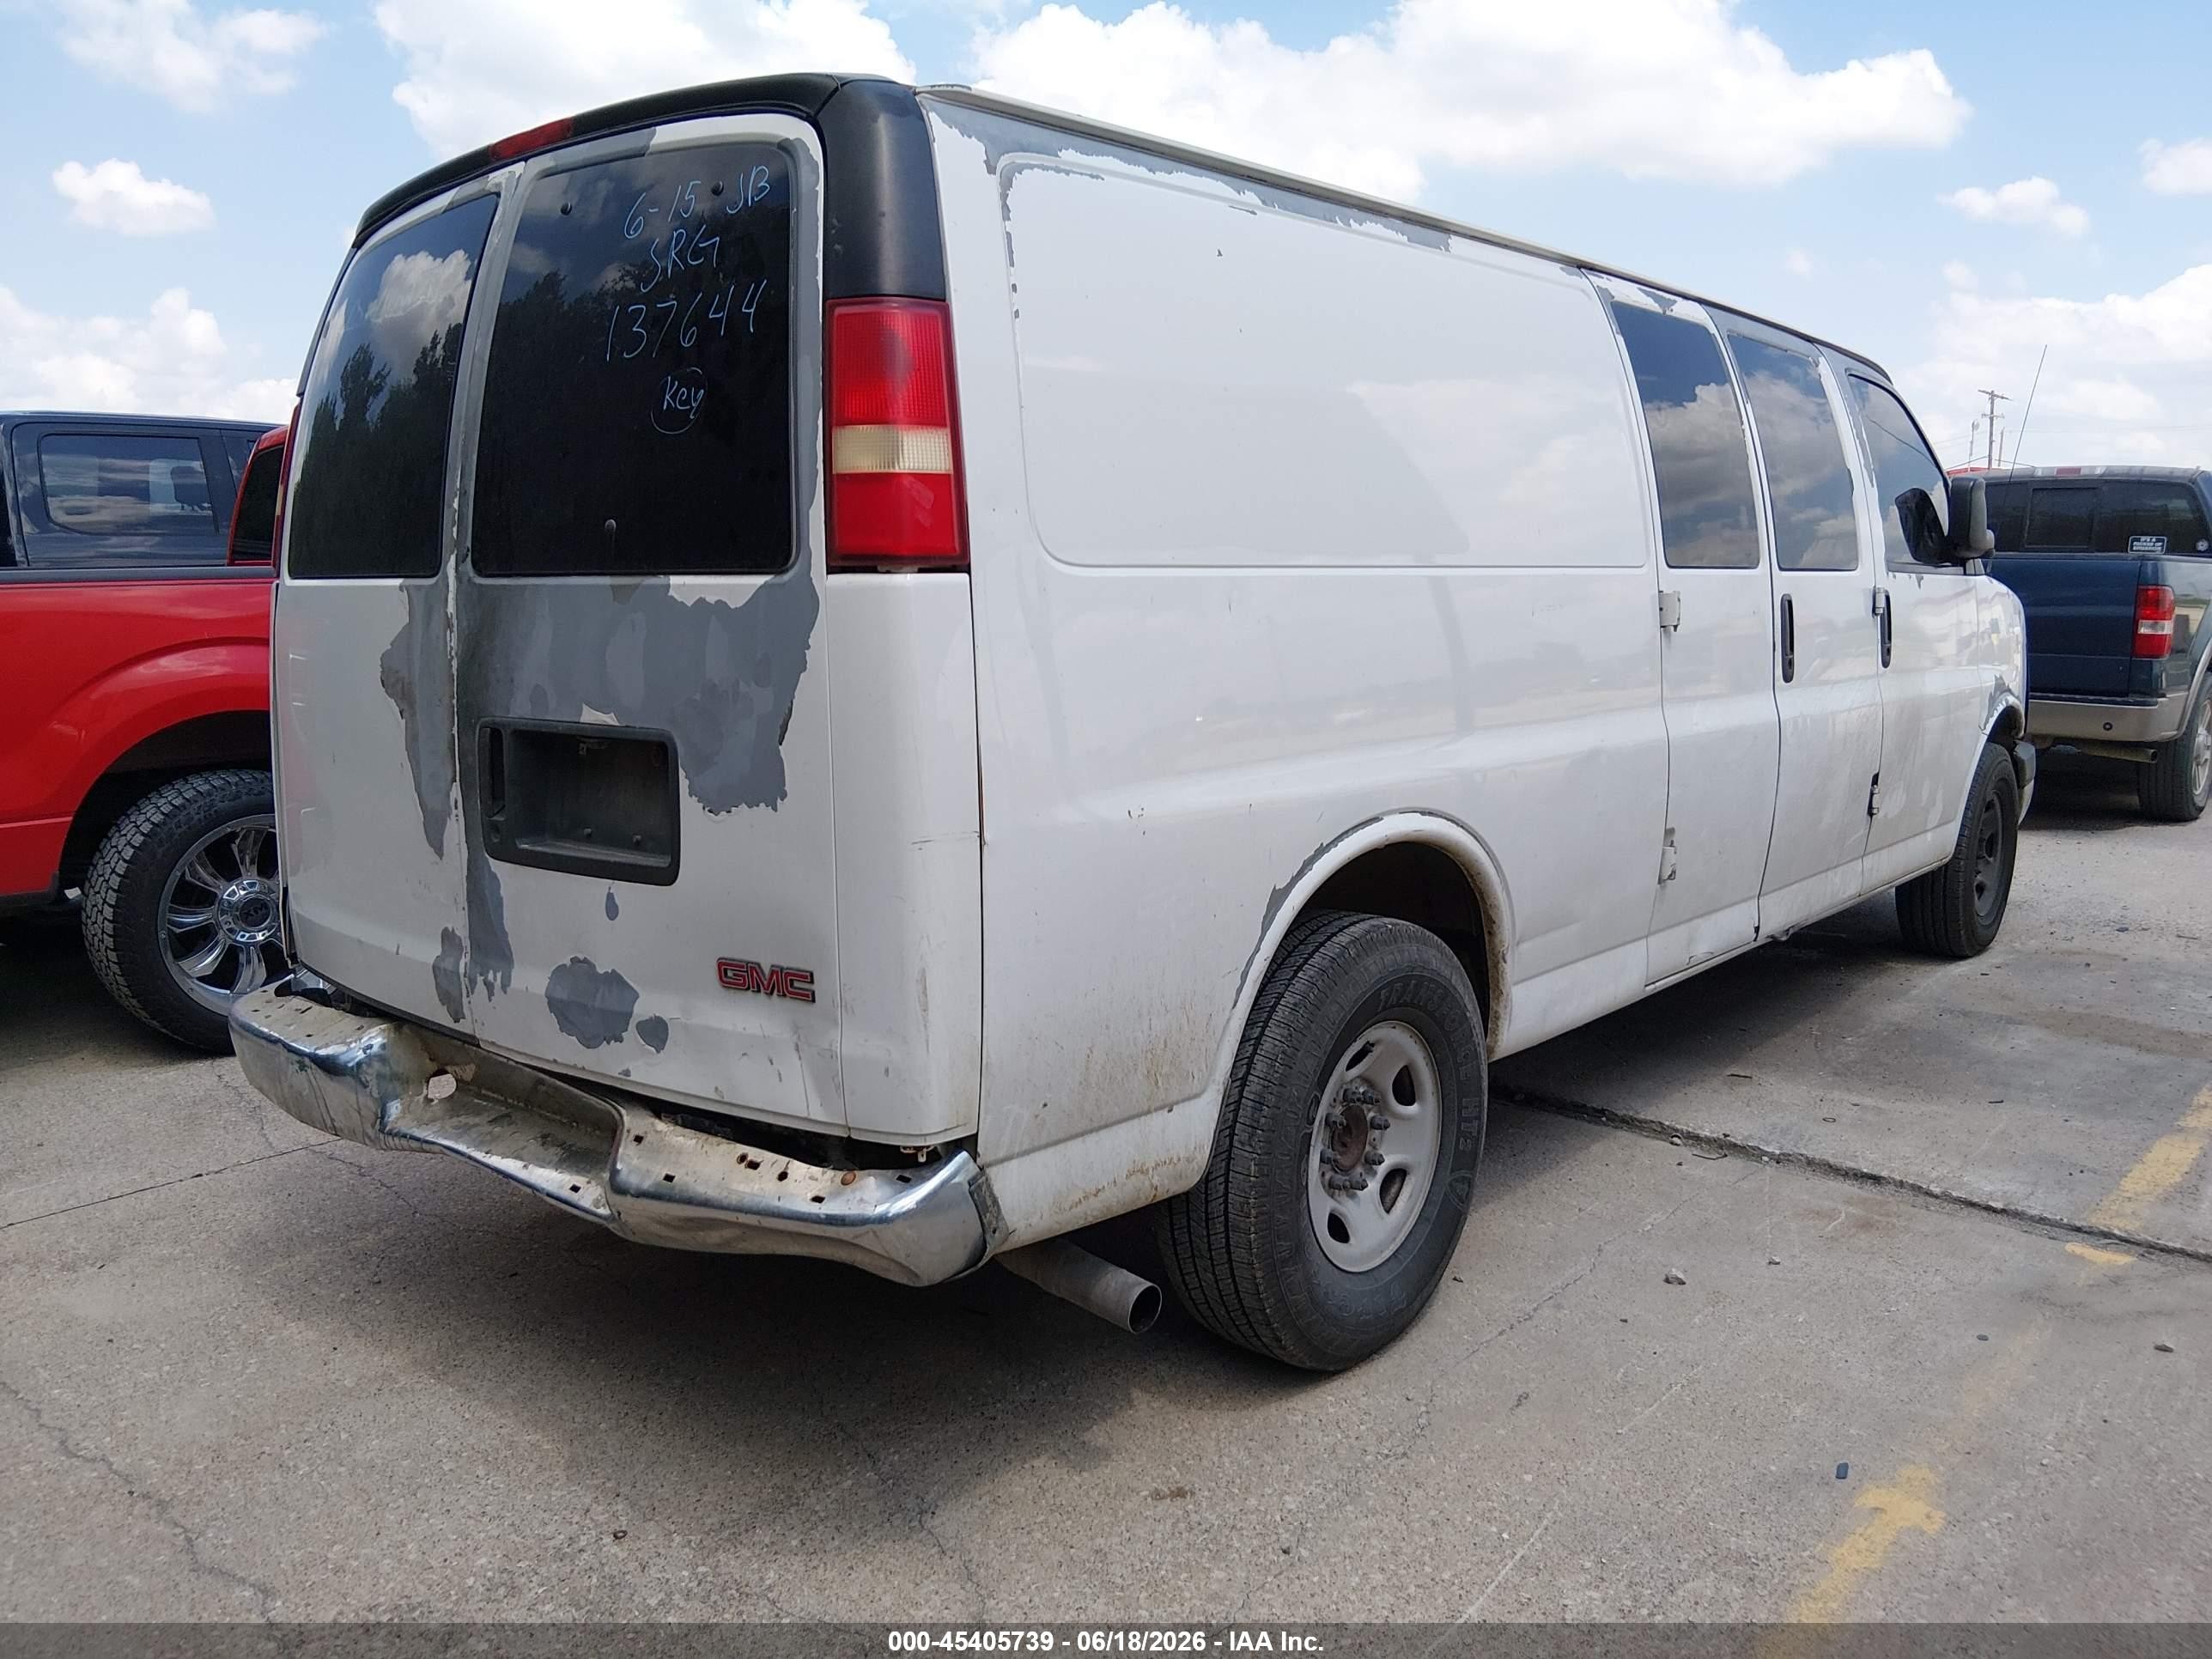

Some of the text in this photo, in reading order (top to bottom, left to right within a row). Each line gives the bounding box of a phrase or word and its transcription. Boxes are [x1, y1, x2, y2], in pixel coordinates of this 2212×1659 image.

[623, 180, 702, 239] 6-15
[606, 279, 768, 362] 137644
[716, 957, 816, 1003] GMC
